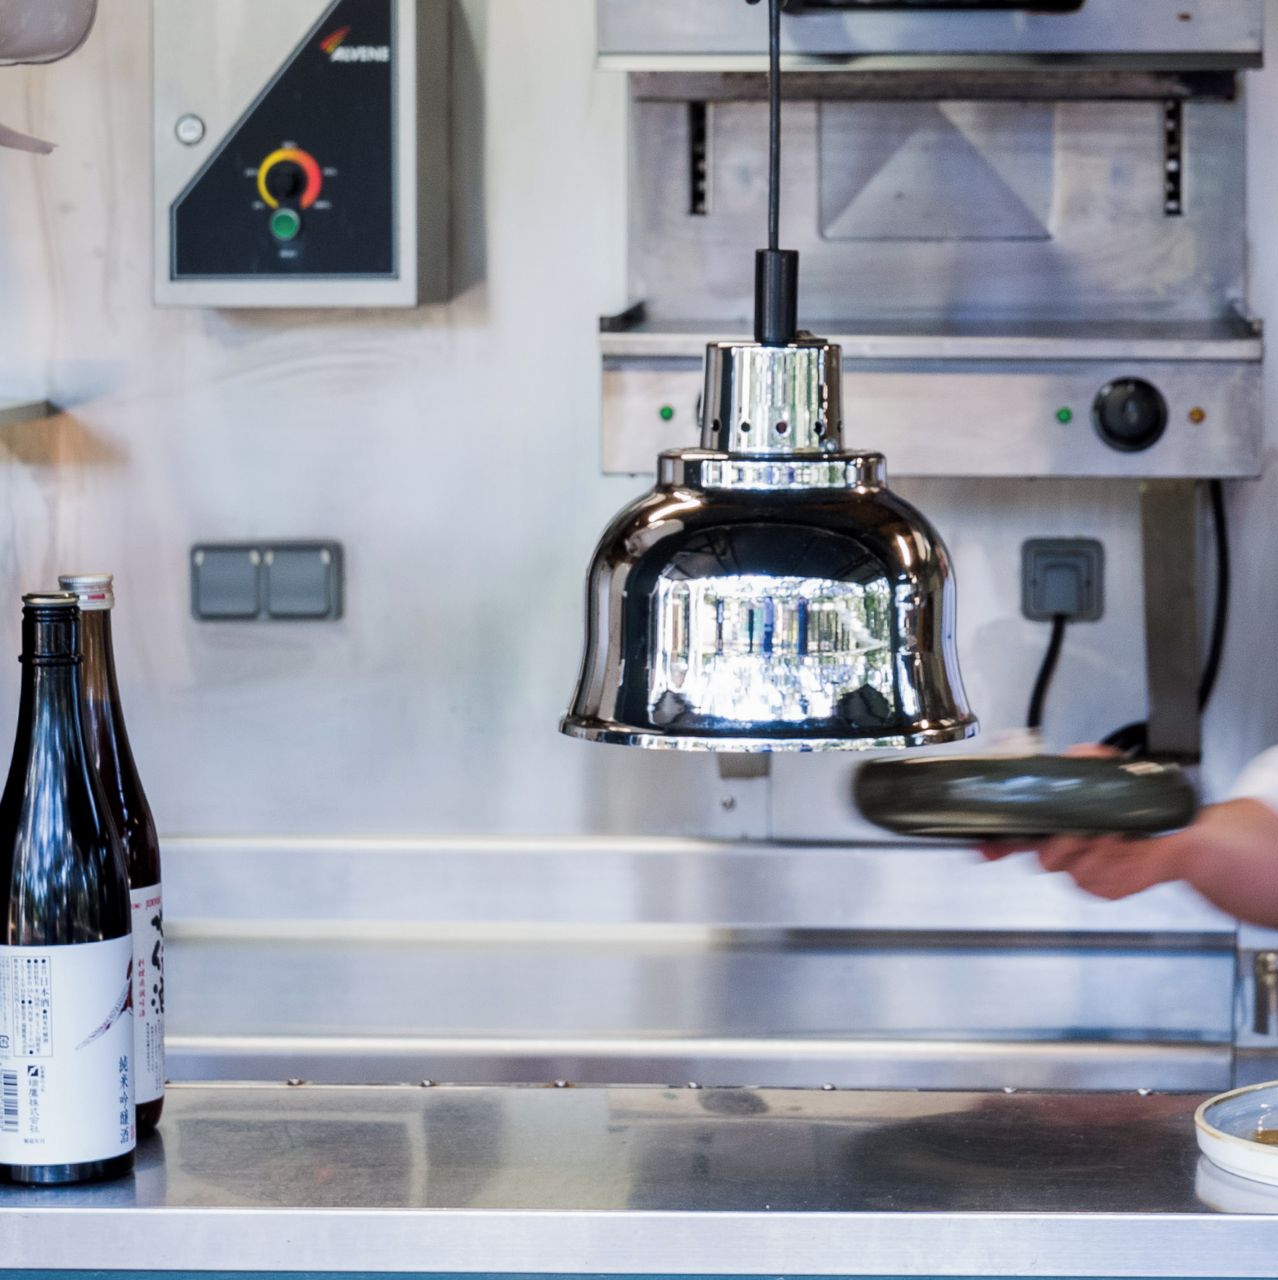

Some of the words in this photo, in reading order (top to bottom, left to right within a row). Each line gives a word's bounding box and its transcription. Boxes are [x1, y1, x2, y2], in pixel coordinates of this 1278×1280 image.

[118, 1055, 130, 1144] 純米吟醸酒
